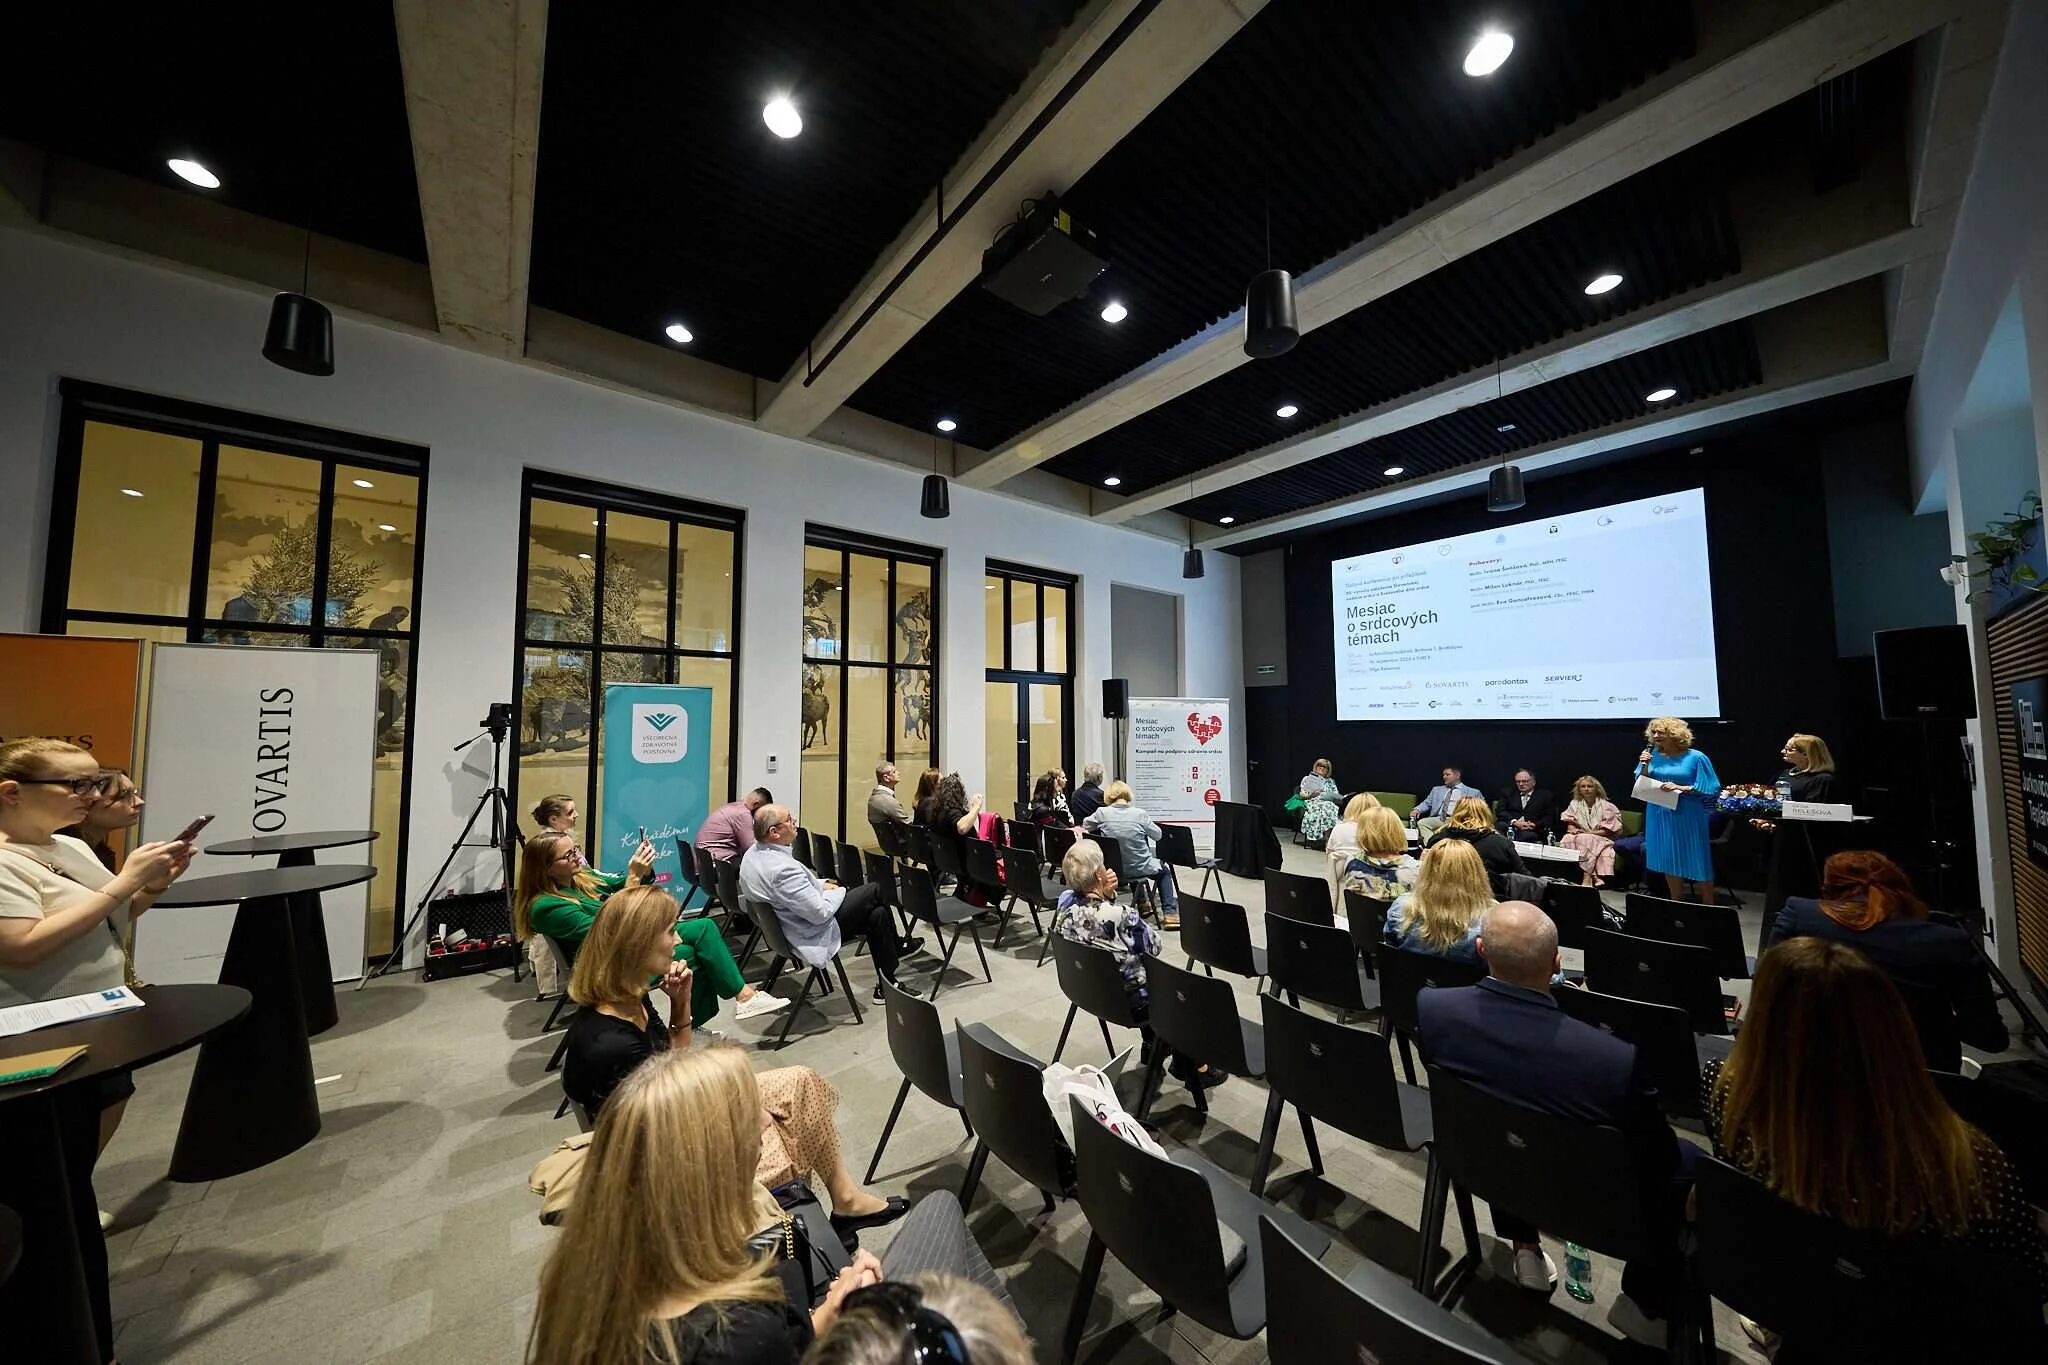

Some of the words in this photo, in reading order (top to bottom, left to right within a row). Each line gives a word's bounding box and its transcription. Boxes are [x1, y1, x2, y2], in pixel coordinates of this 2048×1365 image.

[1347, 603, 1396, 619] Mesiac
[1347, 623, 1356, 633] o
[1360, 610, 1438, 631] srdcových
[1348, 629, 1400, 646] témach
[1485, 678, 1529, 687] parodontax
[1141, 725, 1175, 733] srdcových
[252, 687, 294, 857] OVARTIS
